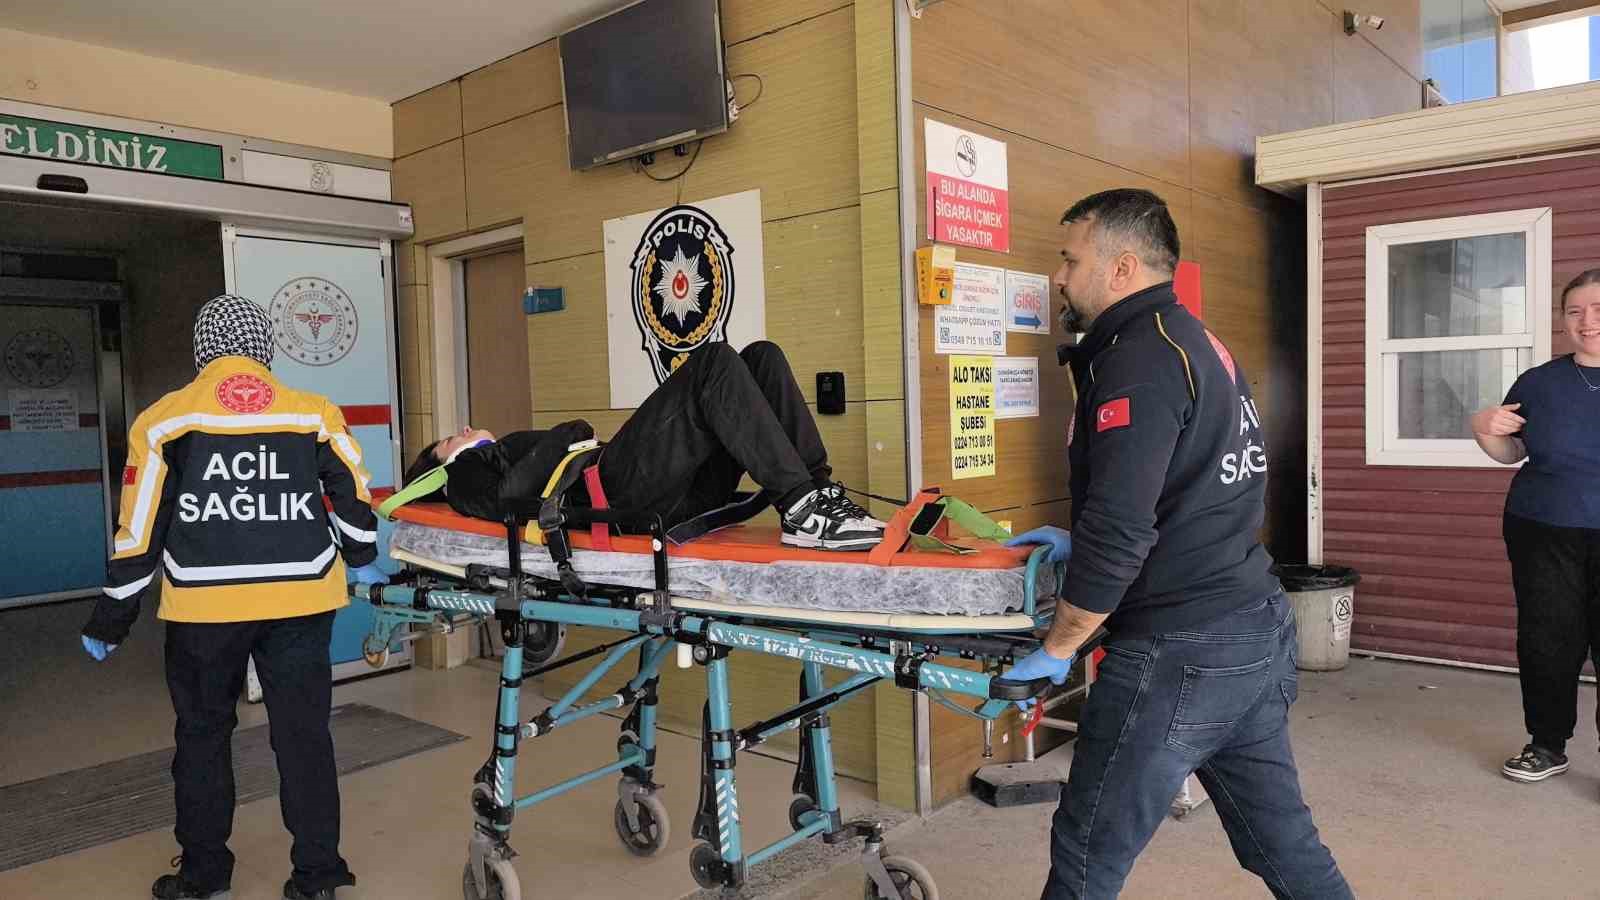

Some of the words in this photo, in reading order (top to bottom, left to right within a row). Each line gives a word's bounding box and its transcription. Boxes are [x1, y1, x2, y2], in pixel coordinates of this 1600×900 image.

[0, 123, 168, 173] ELDİNİZ
[940, 179, 955, 197] BU
[958, 184, 996, 206] ALANDA
[936, 198, 972, 221] SİGARA
[653, 216, 706, 249] POLİS
[946, 225, 993, 246] YASAKTIR
[953, 366, 969, 383] ALO
[969, 366, 992, 383] TAKSİ
[956, 395, 990, 409] HASTANE
[960, 415, 987, 433] ŞUBESİ
[954, 436, 967, 449] 0224
[968, 435, 978, 448] 713
[987, 435, 993, 447] 51
[202, 444, 289, 481] ACİL
[955, 456, 968, 469] 0224
[980, 454, 986, 466] 34
[987, 454, 994, 466] 34
[178, 485, 316, 522] SAĞLIK
